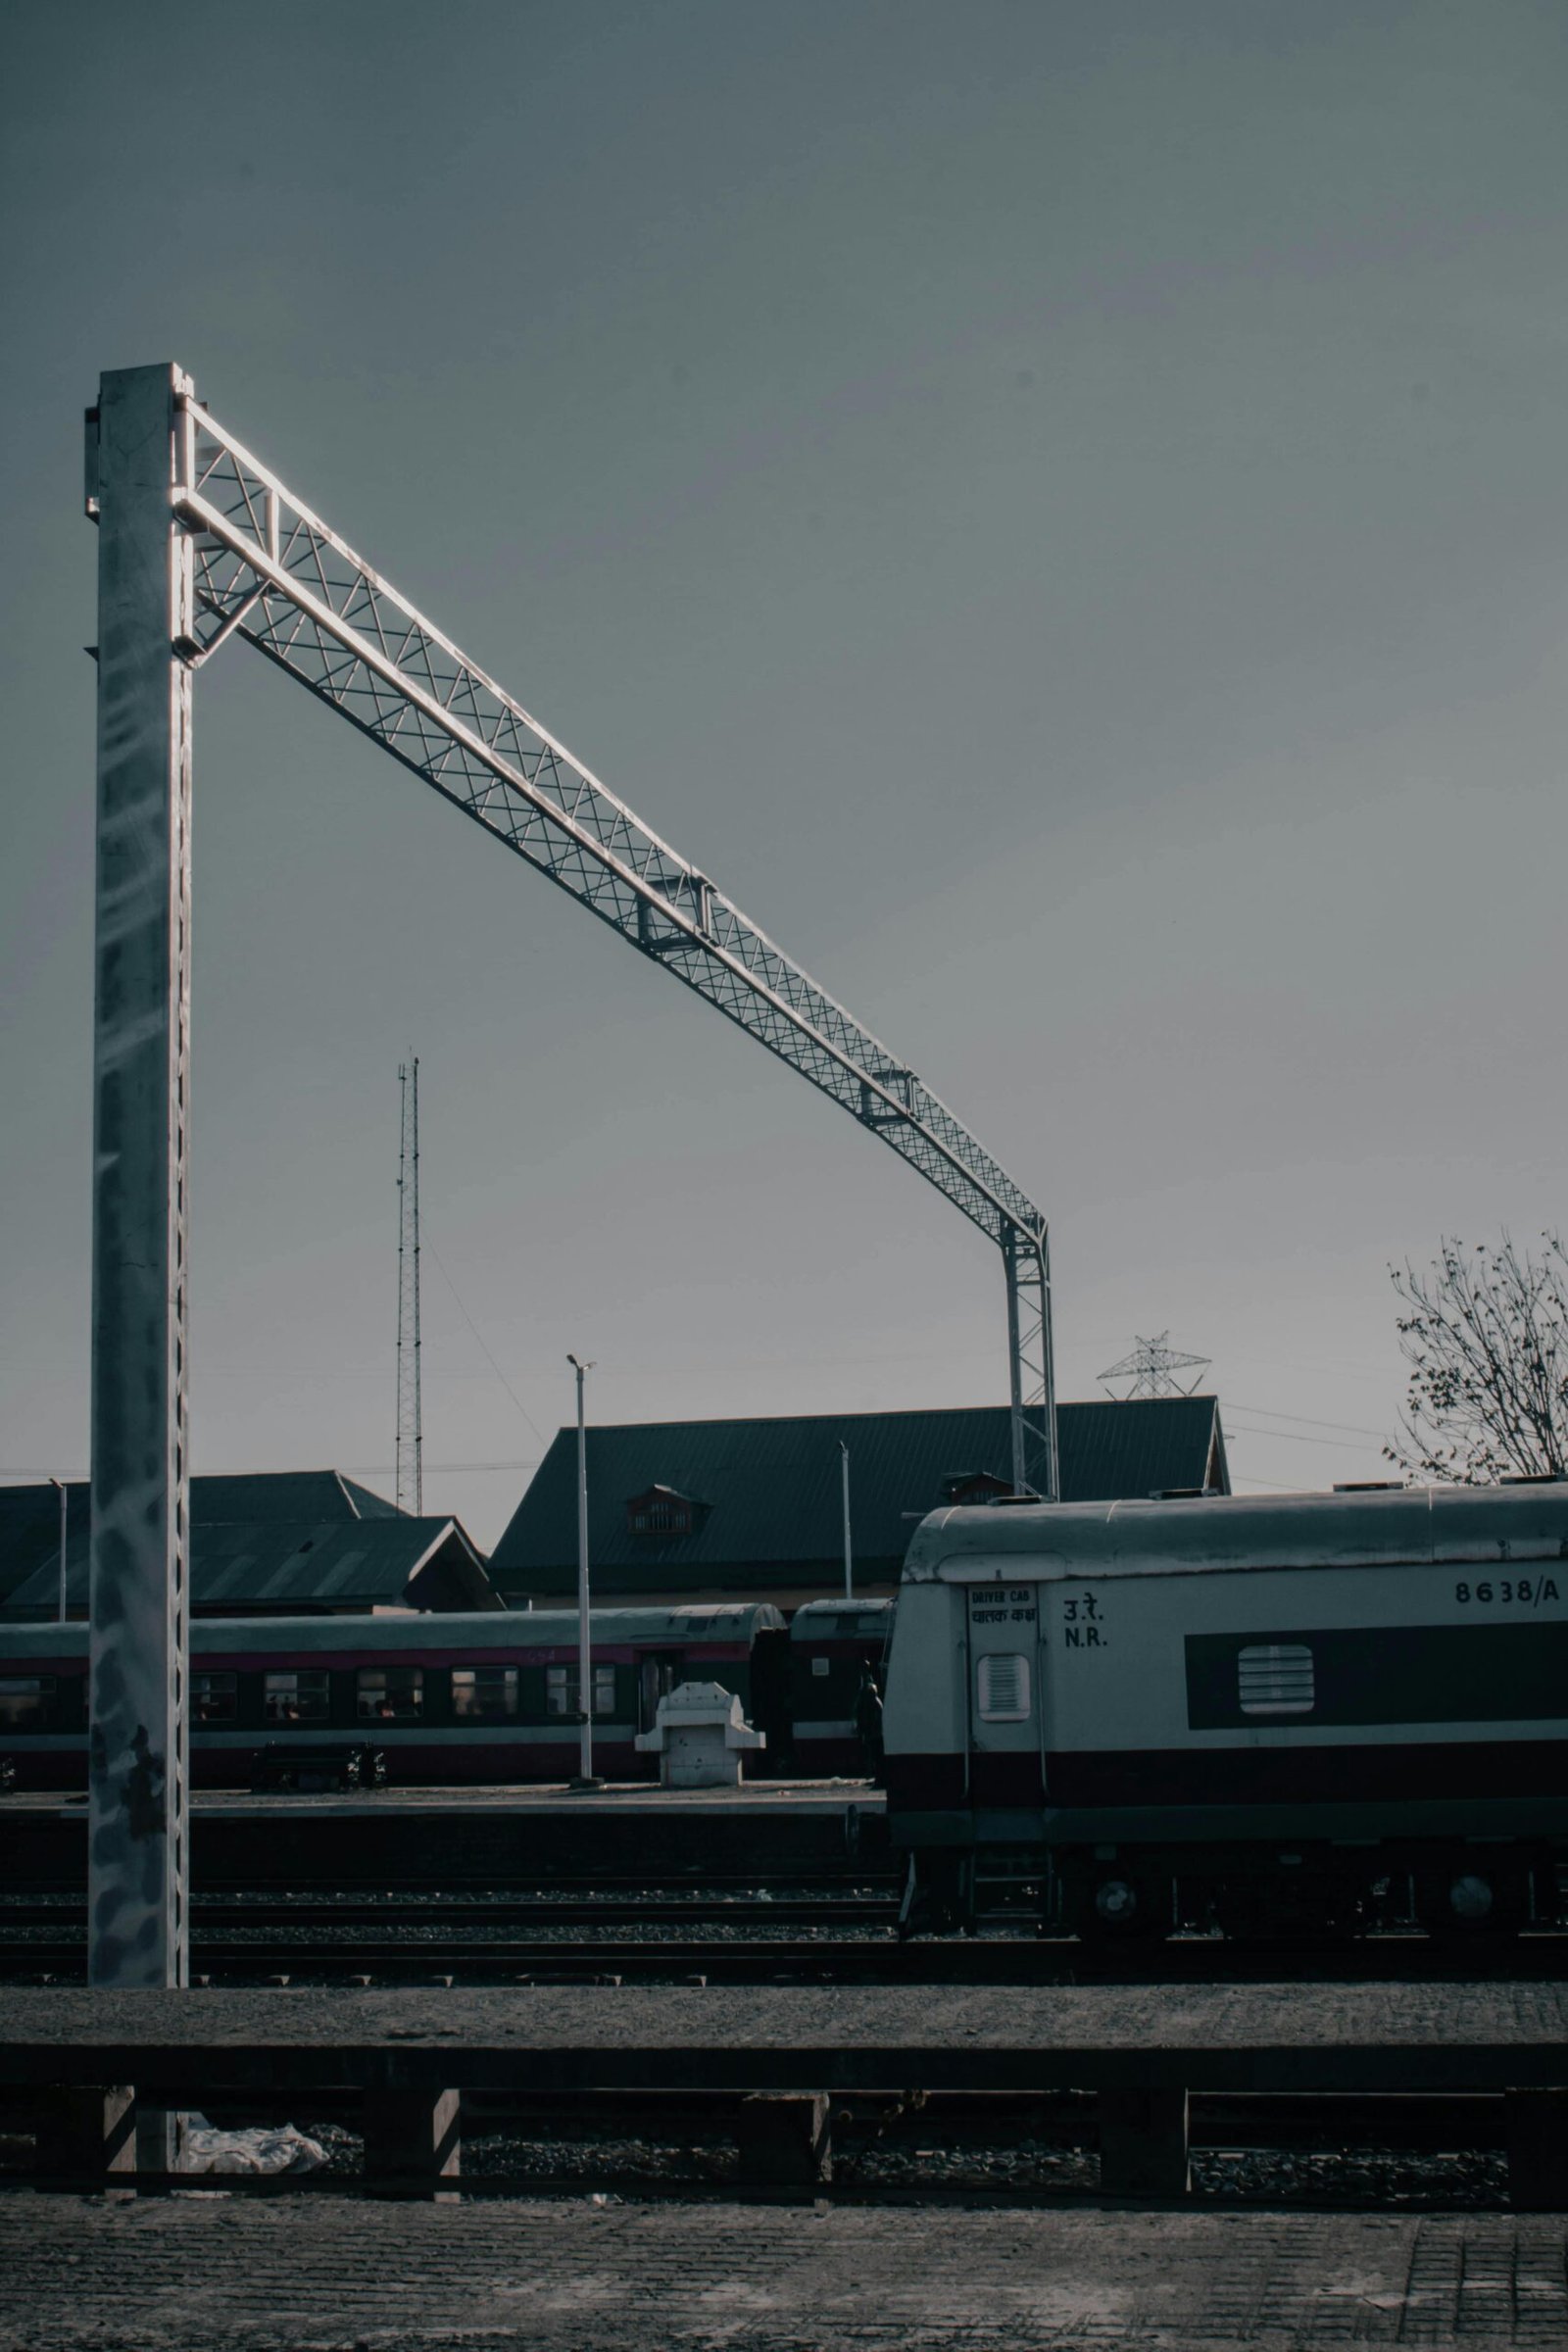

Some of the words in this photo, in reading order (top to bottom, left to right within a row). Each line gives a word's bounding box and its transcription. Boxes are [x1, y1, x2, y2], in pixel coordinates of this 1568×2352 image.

[972, 1591, 1005, 1604] DRIVER
[1010, 1590, 1031, 1602] CAB
[1065, 1627, 1108, 1647] N.R.
